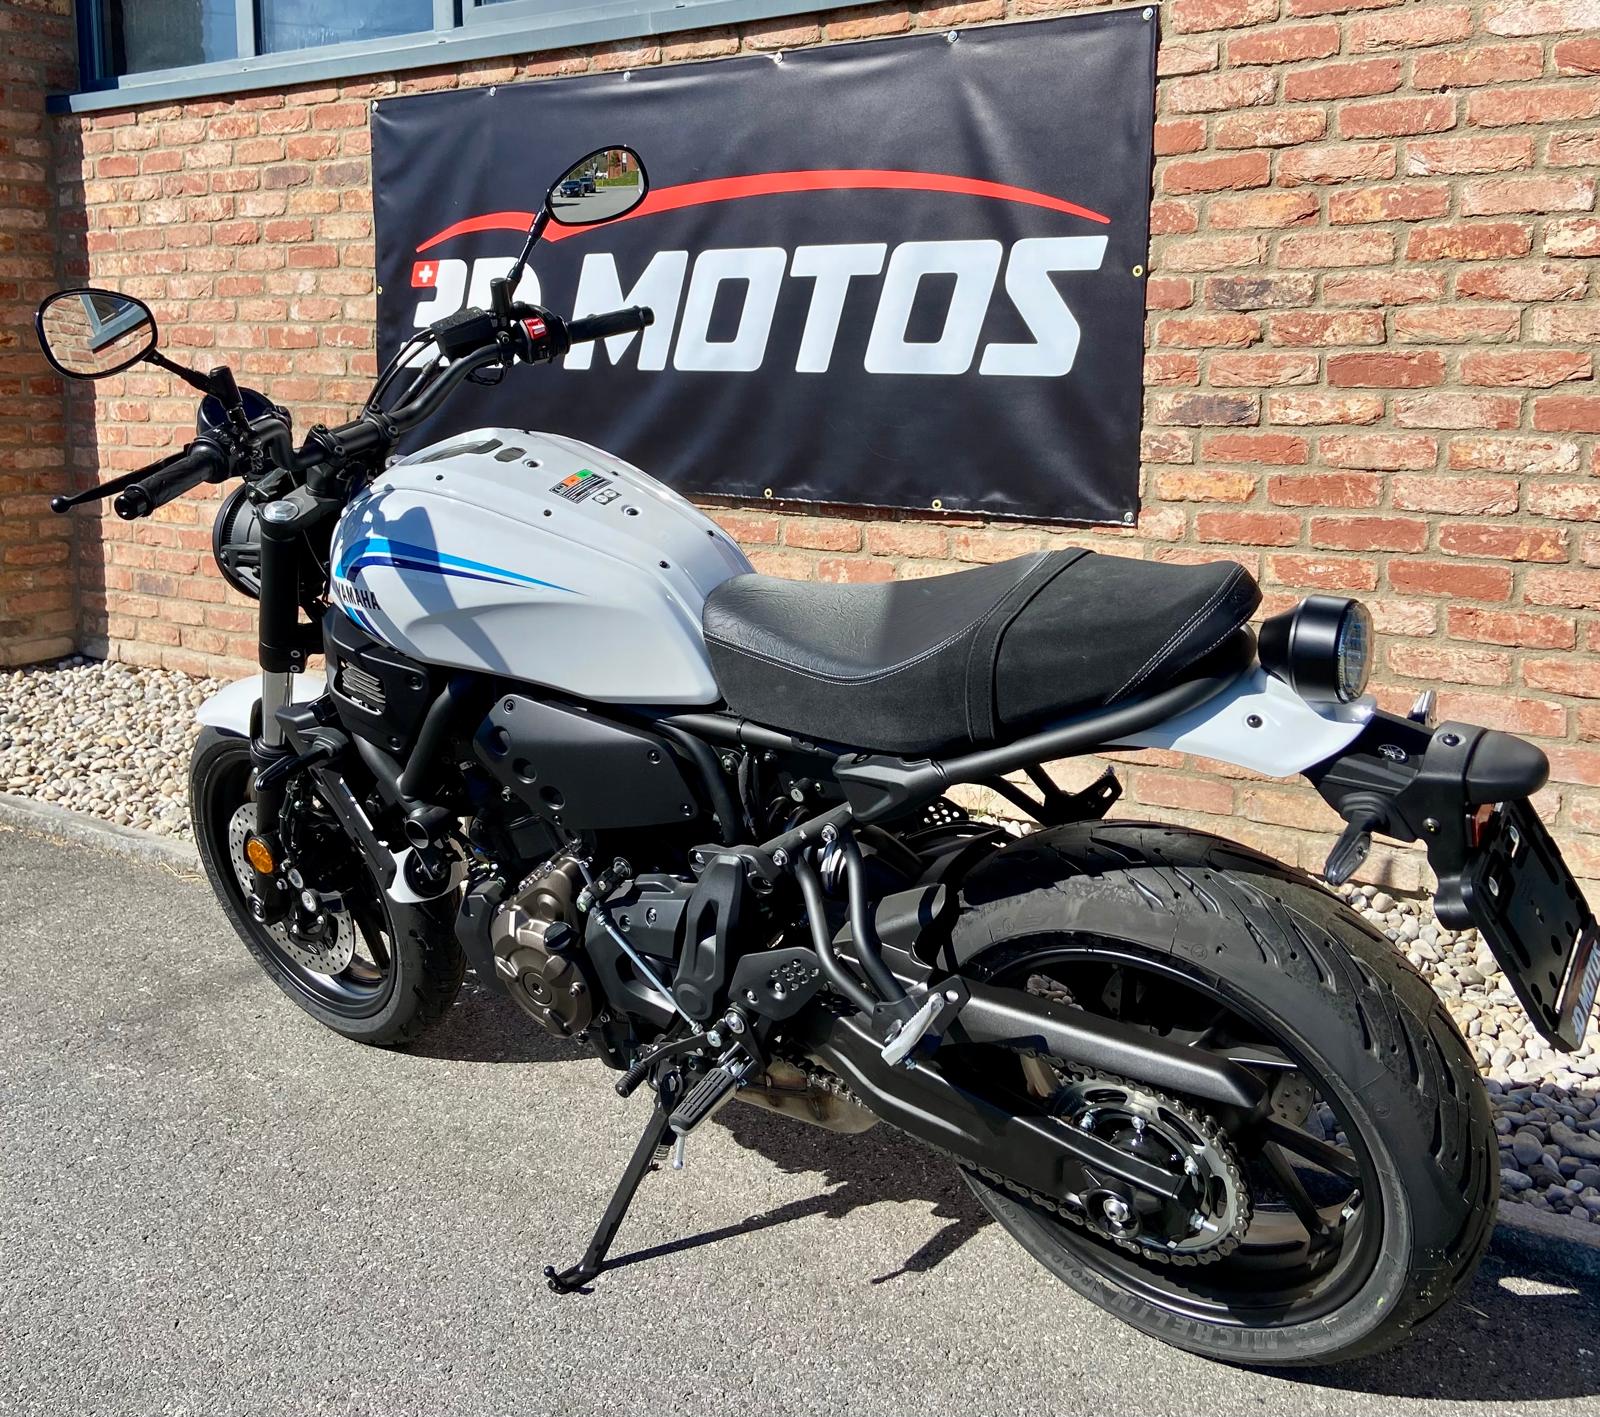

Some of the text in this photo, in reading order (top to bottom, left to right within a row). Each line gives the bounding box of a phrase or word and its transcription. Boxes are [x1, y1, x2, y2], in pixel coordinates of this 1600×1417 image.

[563, 235, 1109, 377] MOTOS
[335, 581, 381, 610] YAMAHA
[1051, 1254, 1278, 1350] MICHELIN ROAD
